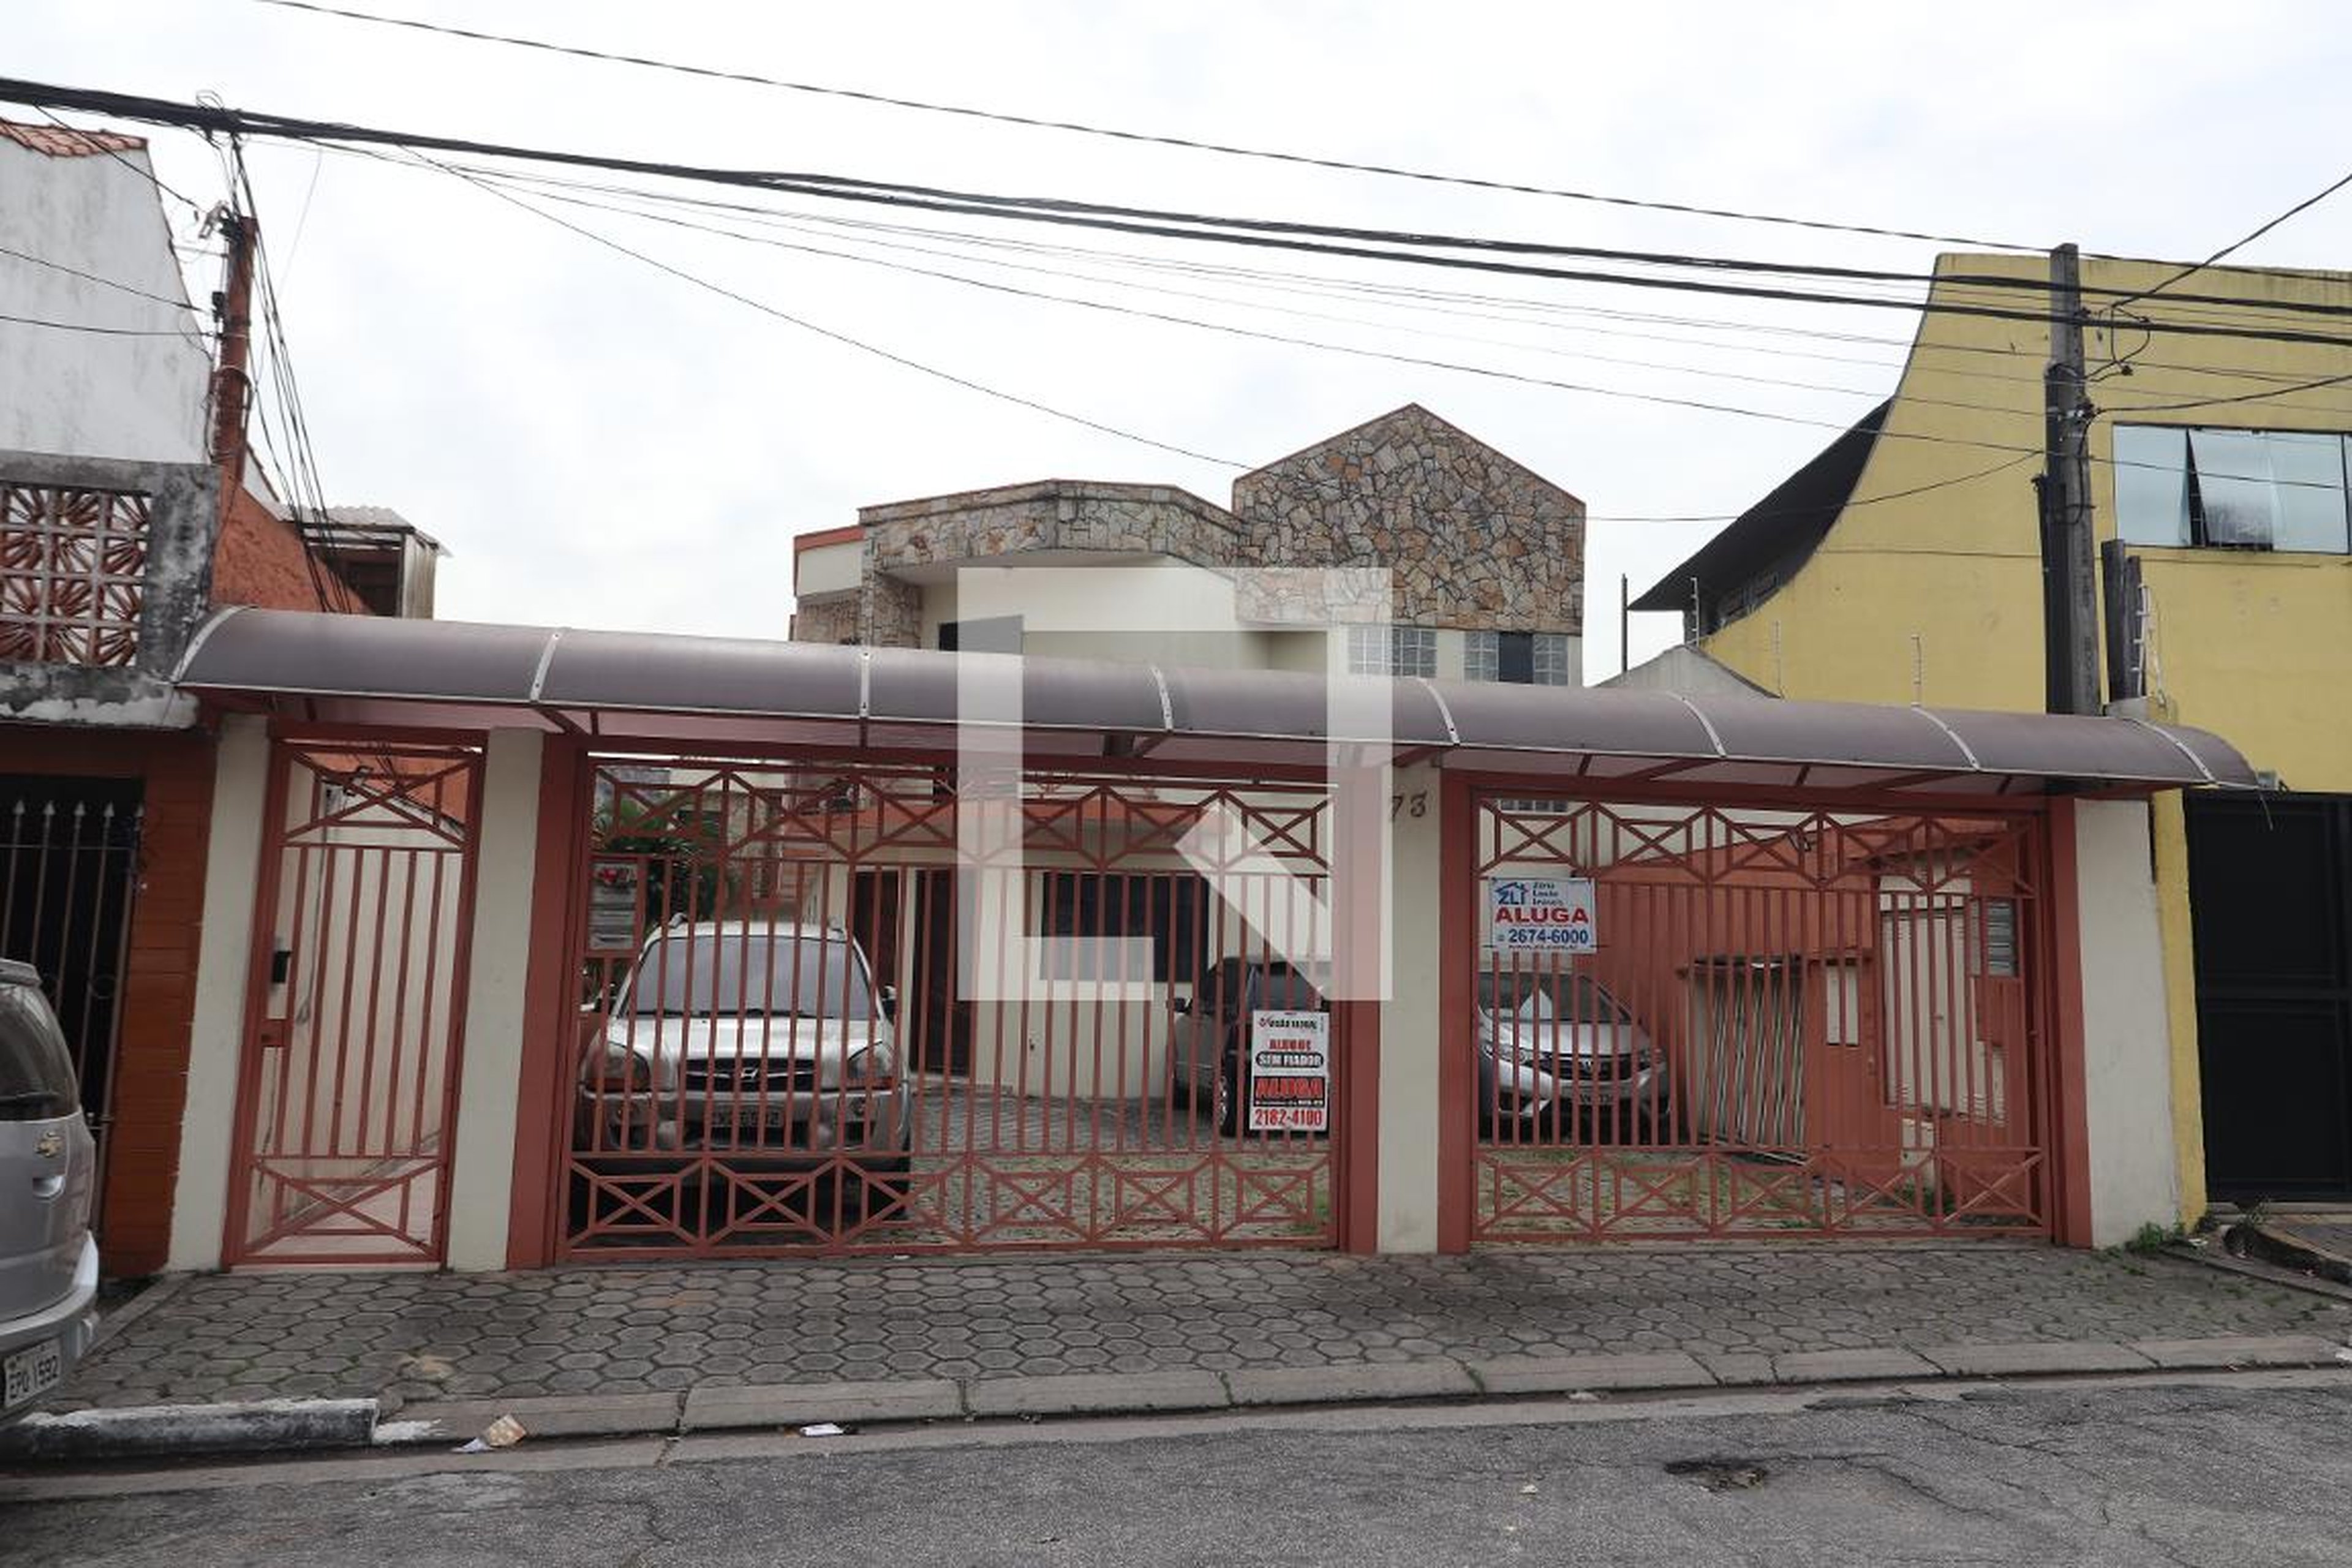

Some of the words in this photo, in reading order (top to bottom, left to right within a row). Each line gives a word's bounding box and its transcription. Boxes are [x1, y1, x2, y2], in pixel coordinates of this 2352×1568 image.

[1494, 907, 1589, 924] ALUGA
[1508, 929, 1589, 944] 2674-6000
[1255, 1109, 1322, 1126] 2182-4100
